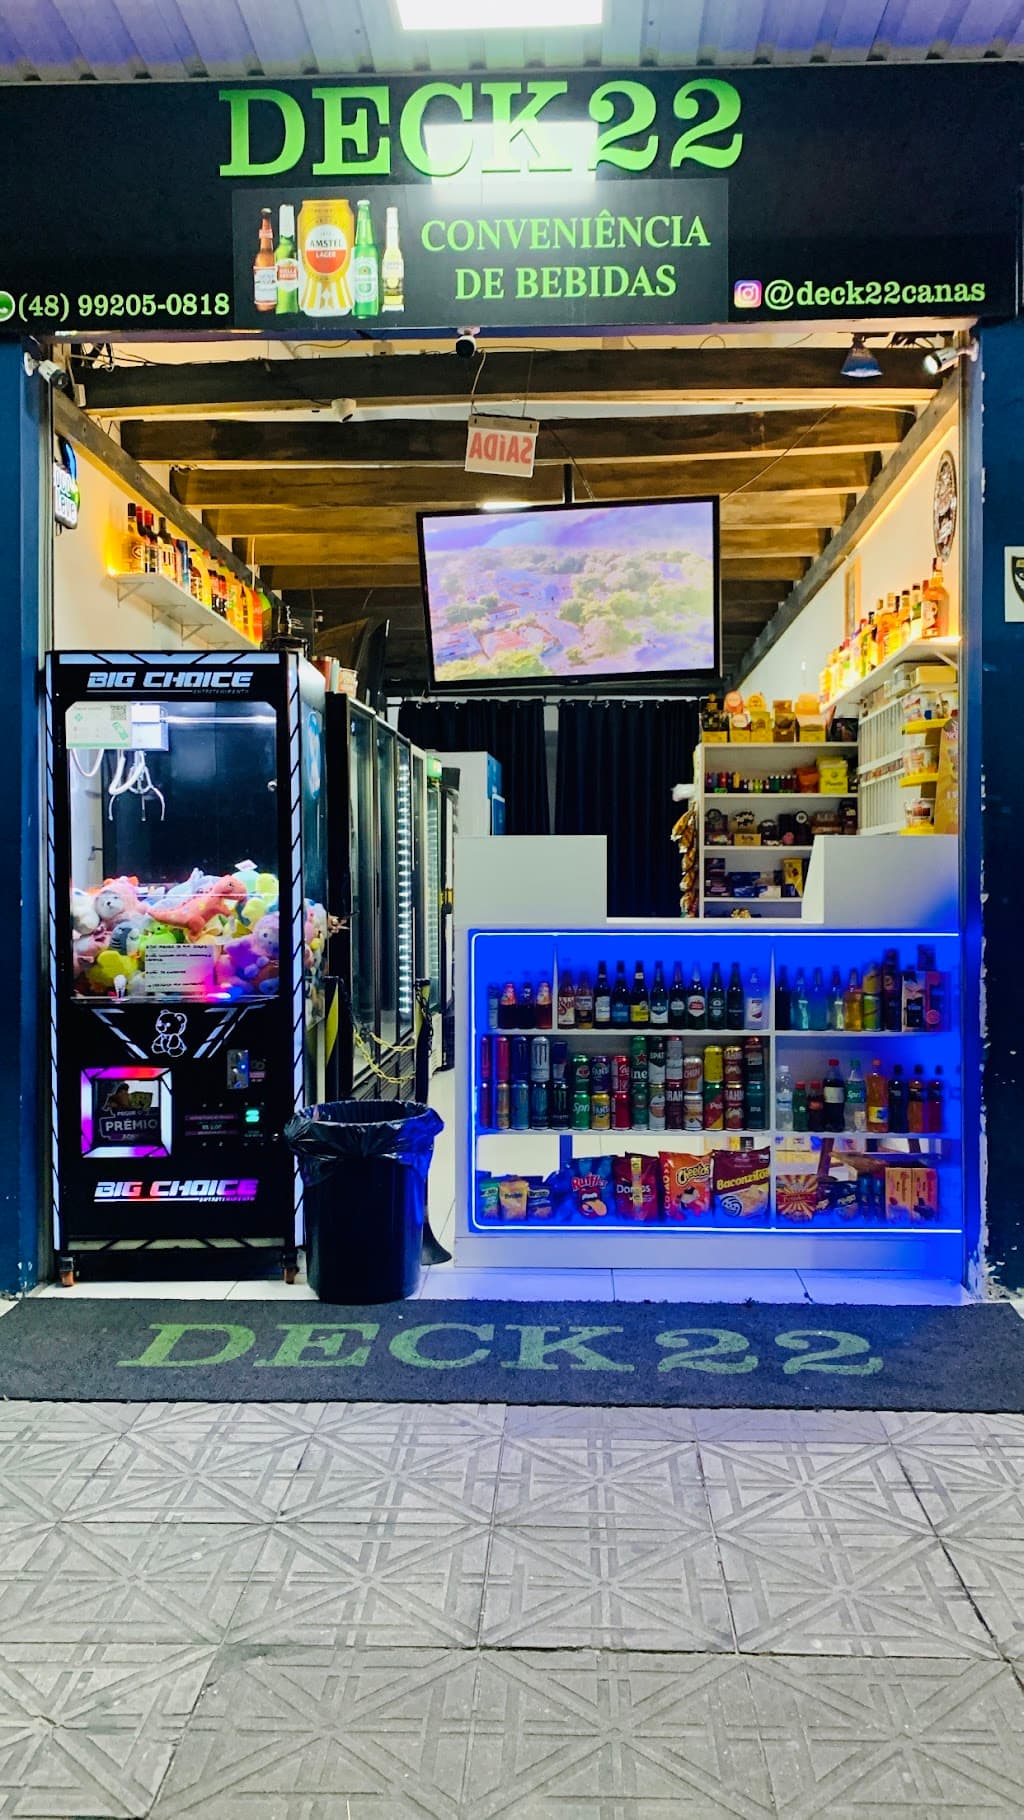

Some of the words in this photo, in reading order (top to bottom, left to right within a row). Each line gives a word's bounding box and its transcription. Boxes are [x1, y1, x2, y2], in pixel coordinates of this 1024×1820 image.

[218, 81, 572, 178] DECK
[588, 78, 744, 172] 22
[421, 209, 711, 252] CONVENIÊNCIA
[455, 268, 504, 300] DE
[515, 264, 677, 299] BEBIDAS
[764, 279, 986, 311] @deck22canas
[18, 293, 69, 320] (48)
[78, 293, 230, 316] 99205-0818
[87, 671, 136, 688] BIG
[143, 671, 254, 688] CHOICE
[94, 1181, 143, 1198] BIG
[150, 1179, 259, 1197] CHOICE
[676, 1163, 711, 1186] Cheetos
[118, 1323, 635, 1373] DECK
[656, 1327, 885, 1376] 22
